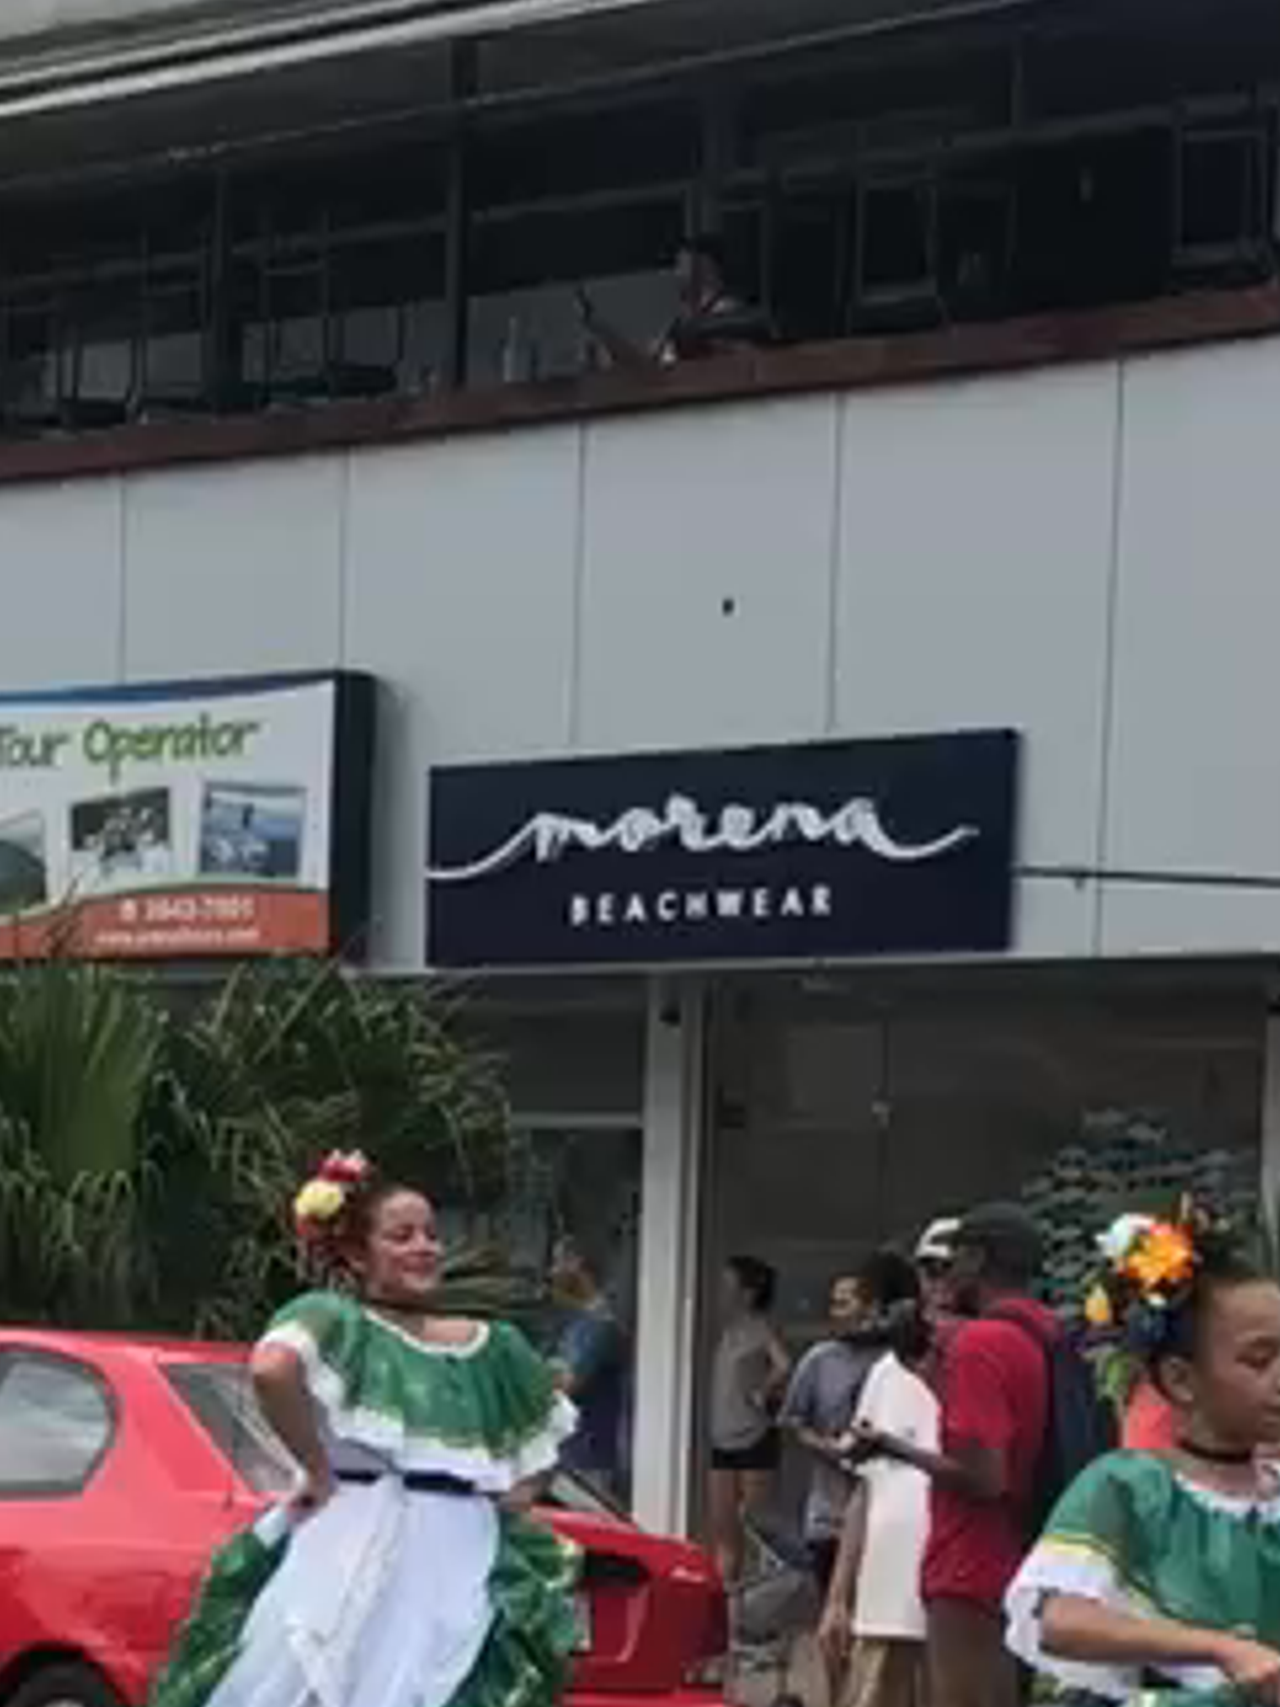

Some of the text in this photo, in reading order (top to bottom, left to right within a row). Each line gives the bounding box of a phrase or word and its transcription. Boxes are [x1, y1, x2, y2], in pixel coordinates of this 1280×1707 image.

[81, 710, 261, 788] Operator
[465, 793, 970, 875] morena
[570, 886, 832, 927] BEACHWEAR
